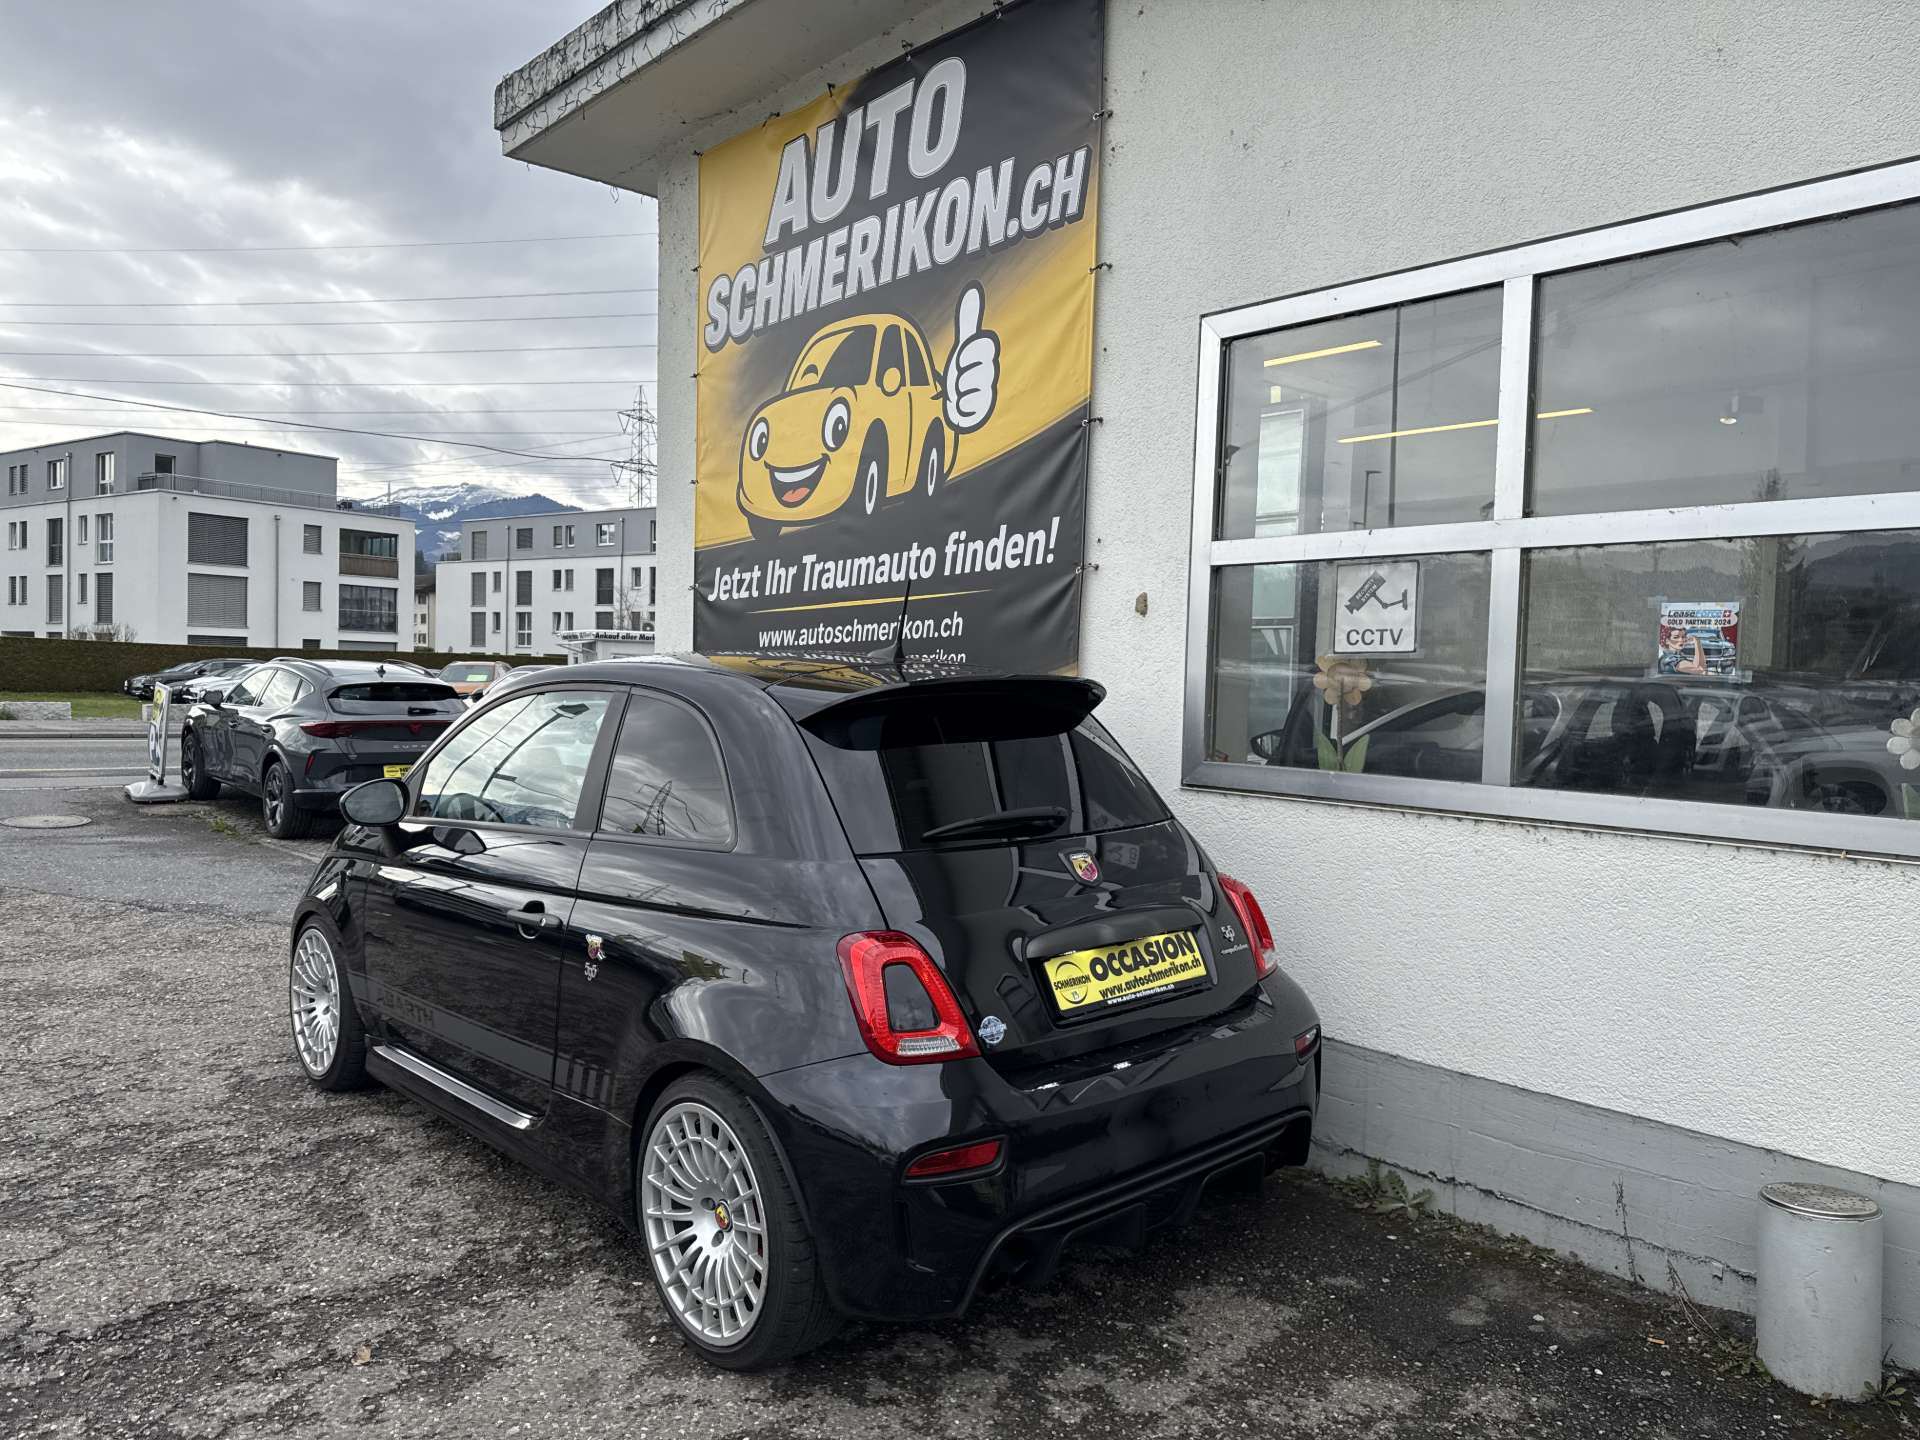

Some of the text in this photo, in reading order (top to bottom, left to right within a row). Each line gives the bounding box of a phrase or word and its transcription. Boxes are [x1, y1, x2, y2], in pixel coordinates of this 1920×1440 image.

[763, 57, 967, 250] AUTO
[704, 145, 1090, 348] SCHMERIKON.CH
[707, 516, 1061, 602] Jetzt Ihr Traumauto finden!
[595, 631, 620, 640] Ankauf
[621, 632, 638, 640] aller
[758, 611, 963, 648] www.autoschmerikon.ch
[1346, 628, 1404, 646] CCTV
[1667, 618, 1732, 626] GOLD PARTNER 2024
[1089, 930, 1196, 981] OCCASION
[1053, 974, 1092, 991] SCHMERIKON
[1099, 954, 1202, 999] www.autoschmerikon.ch
[1107, 983, 1175, 1005] www.auto-schmerikon.ch
